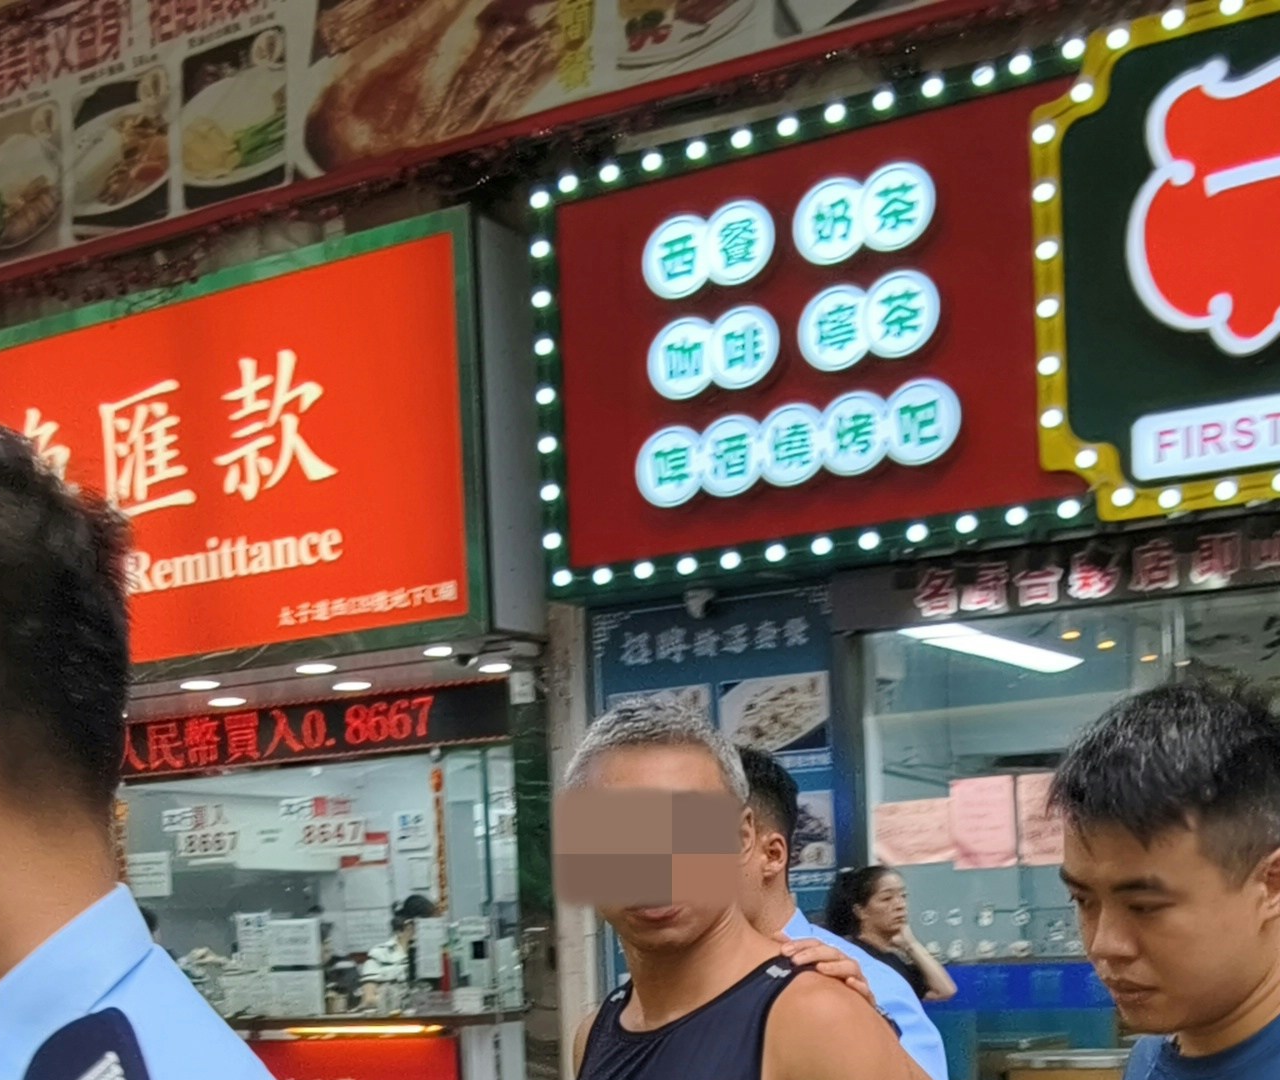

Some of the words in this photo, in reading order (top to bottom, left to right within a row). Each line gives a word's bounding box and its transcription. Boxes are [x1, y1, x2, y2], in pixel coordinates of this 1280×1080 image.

[811, 183, 918, 246] 奶茶
[660, 217, 757, 281] 西餐
[666, 325, 763, 381] 咖啡
[126, 528, 343, 593] Remittance
[344, 697, 434, 745] 8667
